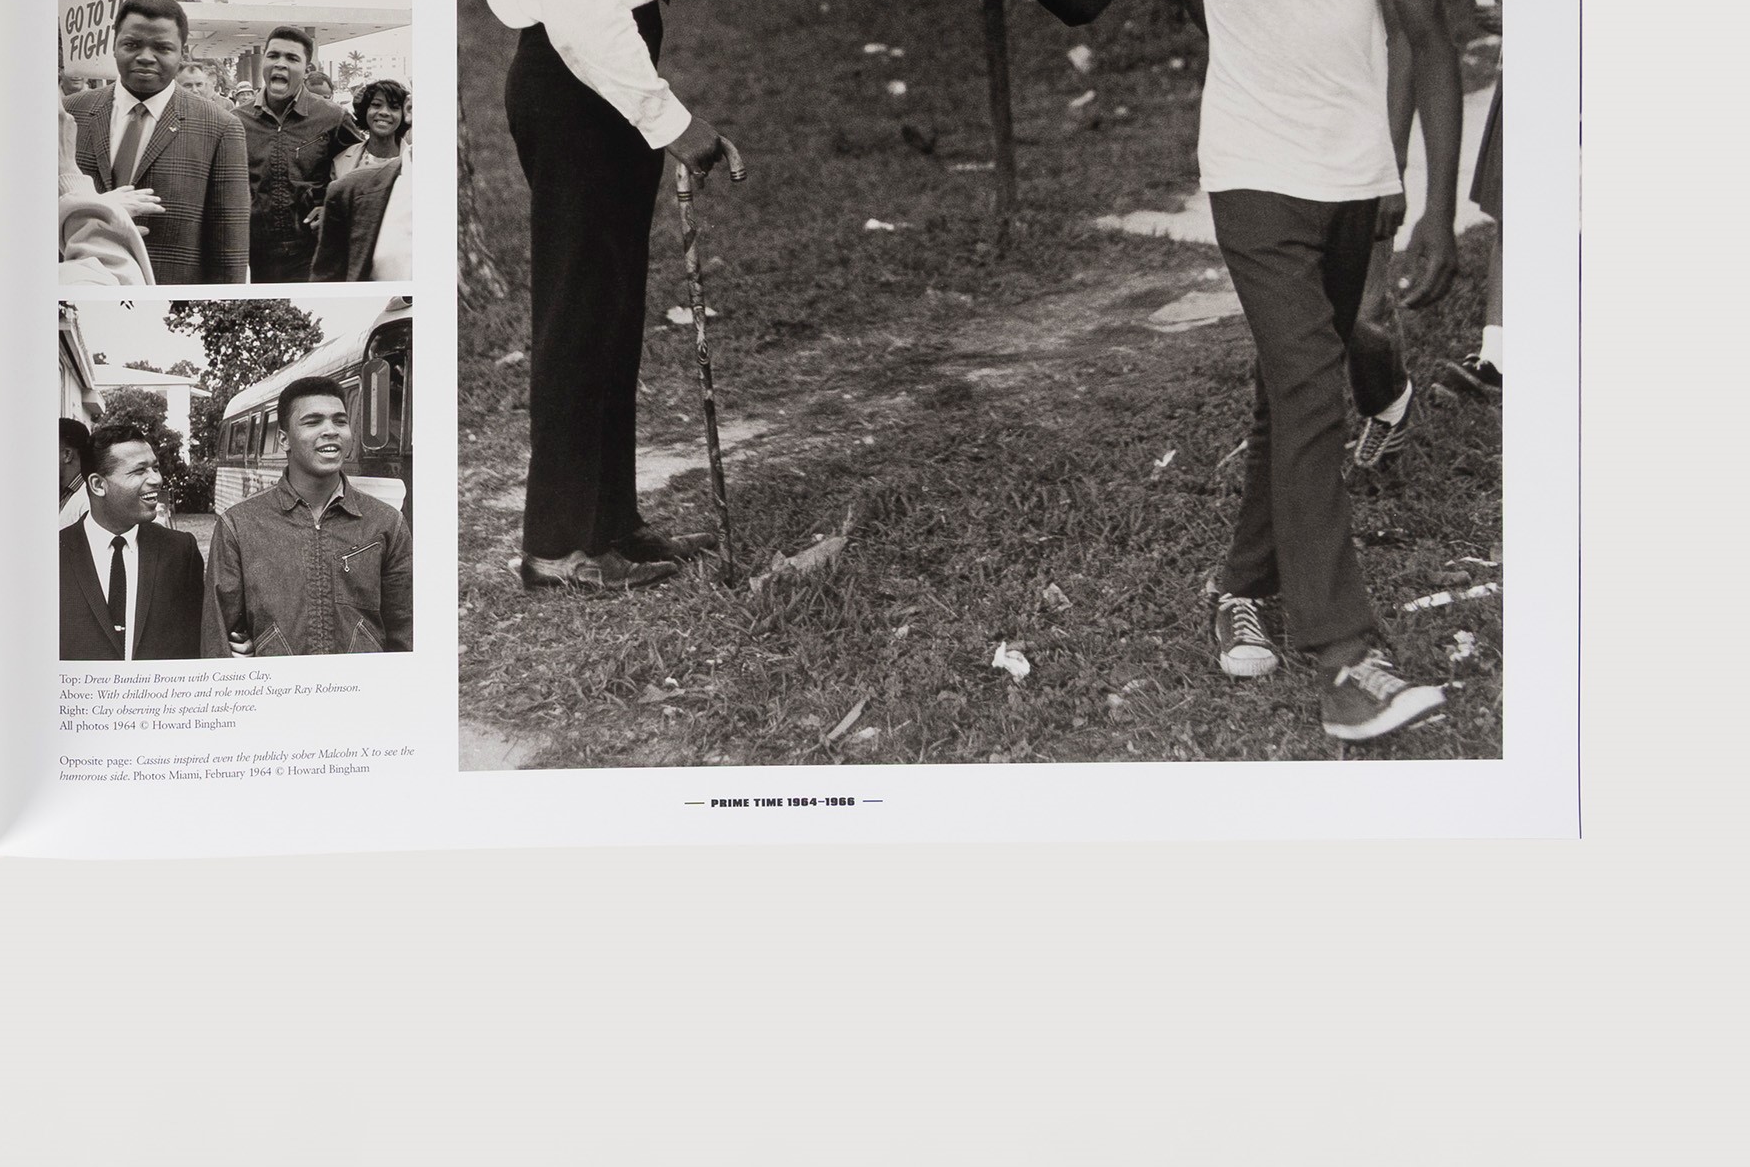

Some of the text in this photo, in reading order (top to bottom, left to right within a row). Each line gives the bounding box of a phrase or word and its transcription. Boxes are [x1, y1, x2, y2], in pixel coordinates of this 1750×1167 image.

[66, 5, 84, 34] GO
[87, 0, 104, 28] TO
[58, 670, 272, 687] Top: Drew Bundini Brown with Cassius Clay.
[59, 682, 361, 700] Above: With childhood hero and role model Sugar Ray Robinson.
[59, 701, 257, 718] Right: Clay observing his special task-force.
[59, 720, 73, 730] All
[76, 720, 110, 733] photos
[113, 720, 136, 730] 1964
[152, 718, 192, 730] Howard
[194, 717, 236, 731] Bingham
[59, 745, 415, 768] Opposite page: Cassius inspired even the publicly sober Malcolm X to see the
[59, 767, 108, 782] humorous
[109, 770, 130, 782] side.
[133, 770, 166, 781] Photos
[168, 769, 202, 780] Miami,
[205, 768, 246, 780] February
[250, 766, 272, 777] 1964
[288, 764, 326, 776] Howard
[329, 763, 370, 776] Bingham
[711, 798, 750, 807] PRIME
[753, 798, 784, 807] TIME
